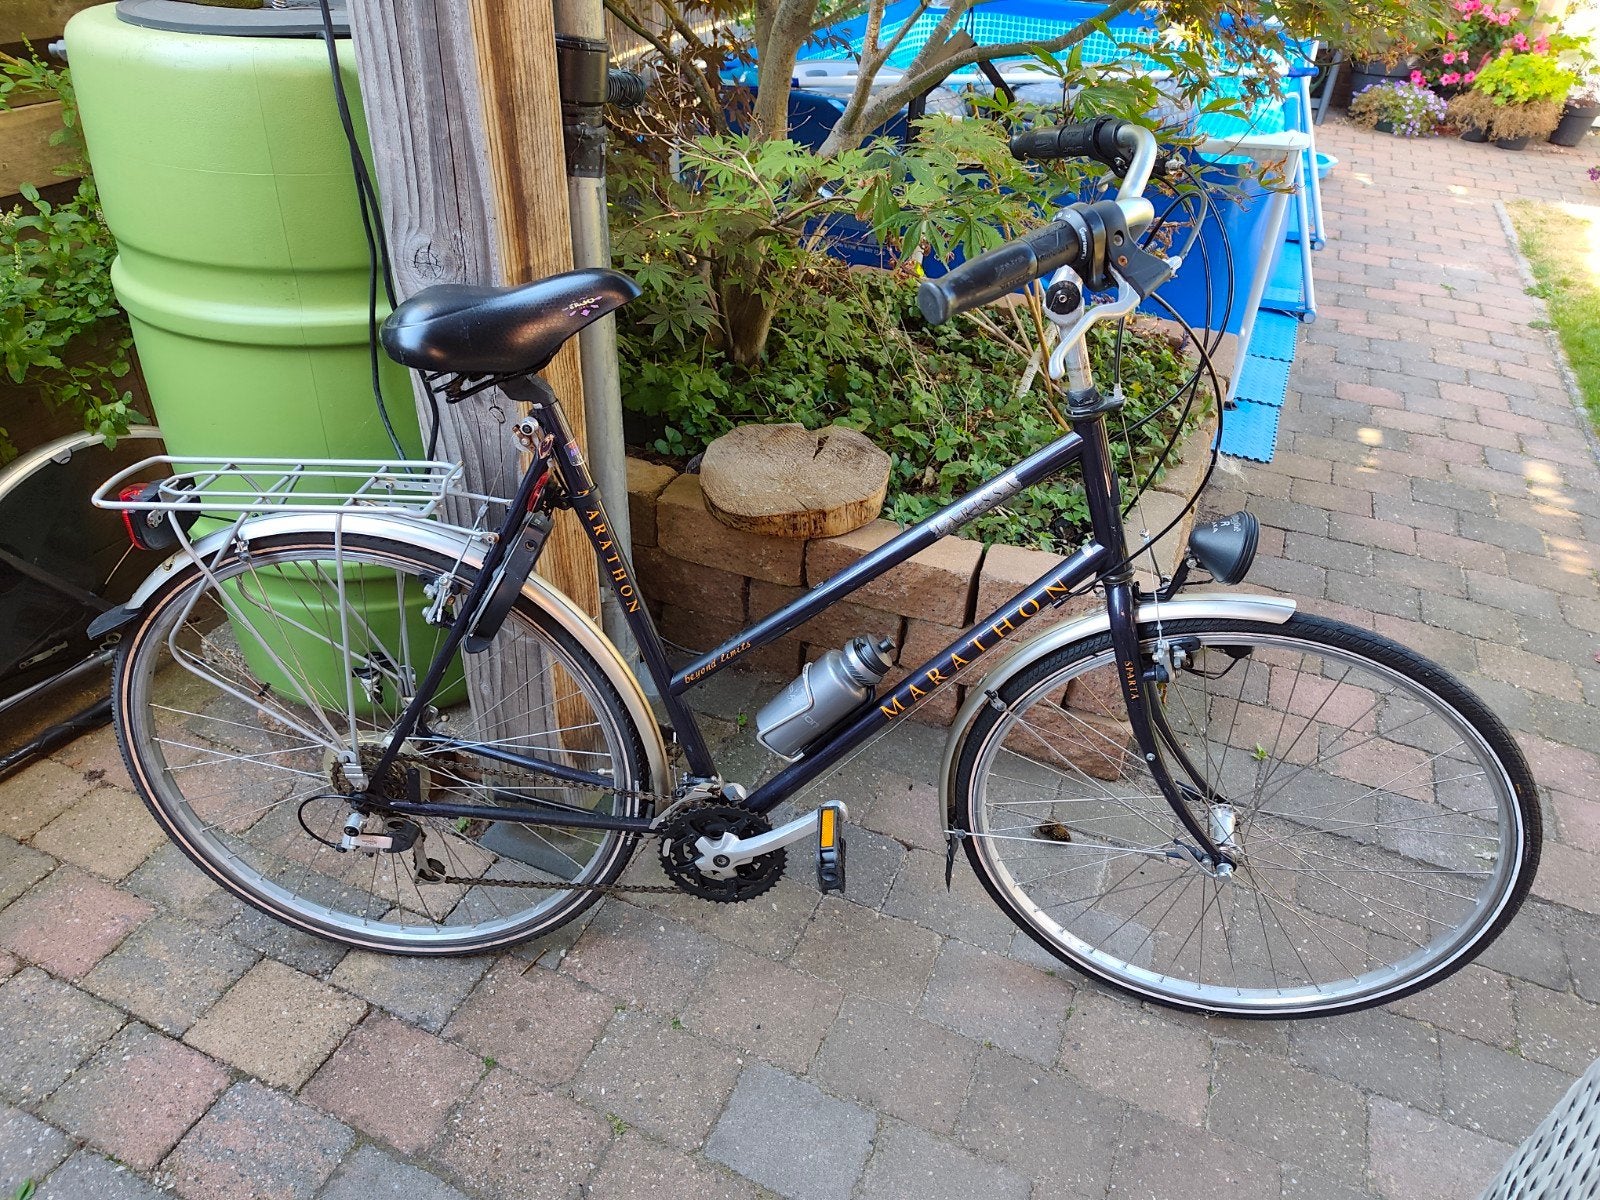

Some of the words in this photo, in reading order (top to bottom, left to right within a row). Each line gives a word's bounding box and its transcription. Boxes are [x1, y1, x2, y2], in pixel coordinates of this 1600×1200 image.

[684, 658, 717, 684] beyond
[720, 640, 751, 663] limits
[879, 577, 1069, 720] MARATHON
[1124, 660, 1140, 700] SPARTA
